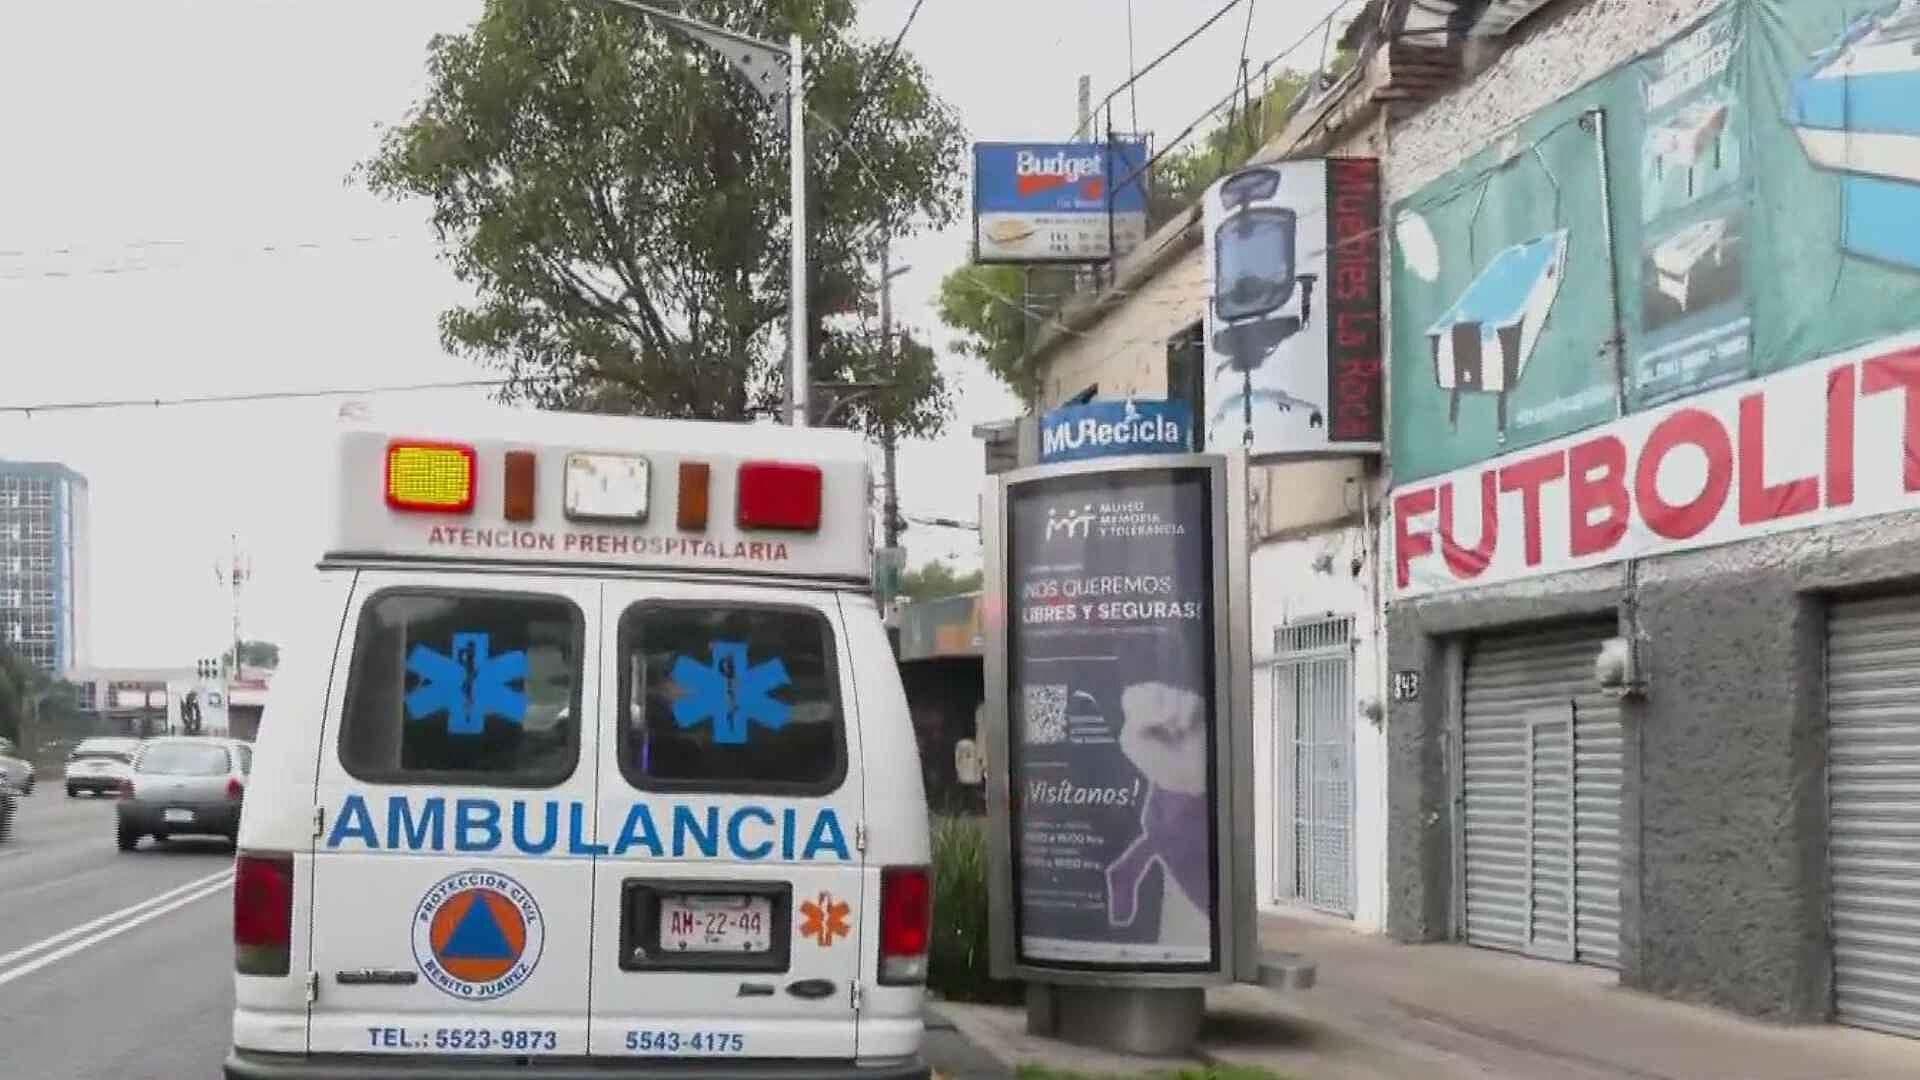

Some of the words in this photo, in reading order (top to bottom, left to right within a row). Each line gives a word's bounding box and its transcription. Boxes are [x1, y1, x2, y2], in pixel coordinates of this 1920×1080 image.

[1016, 150, 1103, 183] Budget
[1337, 311, 1376, 348] La
[428, 526, 554, 551] ATENCION
[564, 533, 789, 561] PREHOSPITALARIA
[1062, 575, 1172, 598] QUEREMOS
[1022, 603, 1077, 624] LIBRES
[1082, 604, 1094, 620] Y
[1393, 672, 1418, 699] 843
[328, 796, 851, 861] AMBULANCIA
[510, 888, 537, 925] CIVIL
[670, 911, 761, 935] AM-22-44
[424, 959, 473, 995] BENITO
[478, 961, 530, 996] JUAREZ
[368, 1028, 428, 1048] TEL.:
[435, 1028, 557, 1050] 5523-9873
[625, 1030, 744, 1052] 5543-4175
